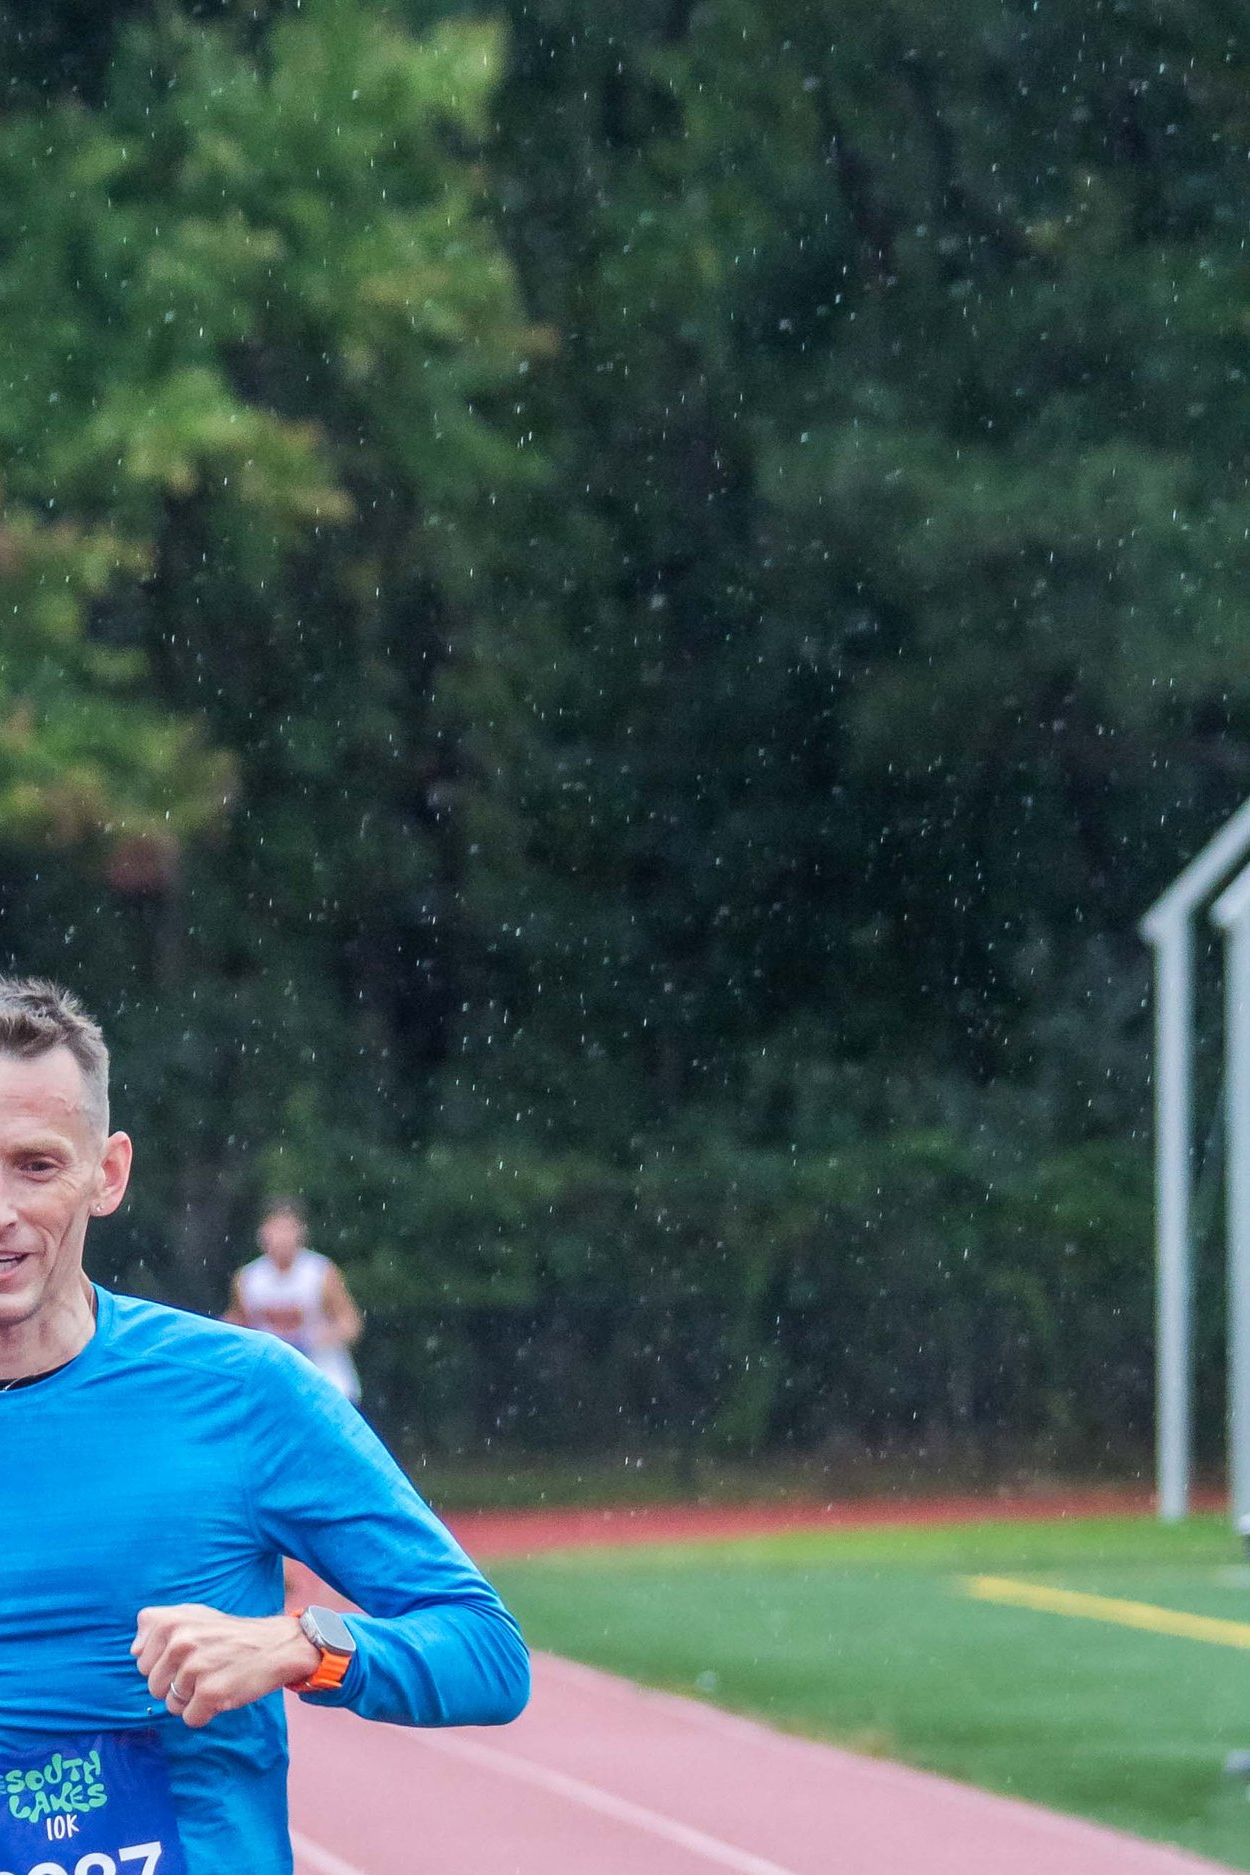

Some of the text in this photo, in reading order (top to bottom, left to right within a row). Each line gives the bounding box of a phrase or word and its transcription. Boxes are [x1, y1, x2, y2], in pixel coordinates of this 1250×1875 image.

[5, 1750, 101, 1793] SOUTH
[9, 1782, 108, 1823] LAKES
[46, 1813, 80, 1841] 10K
